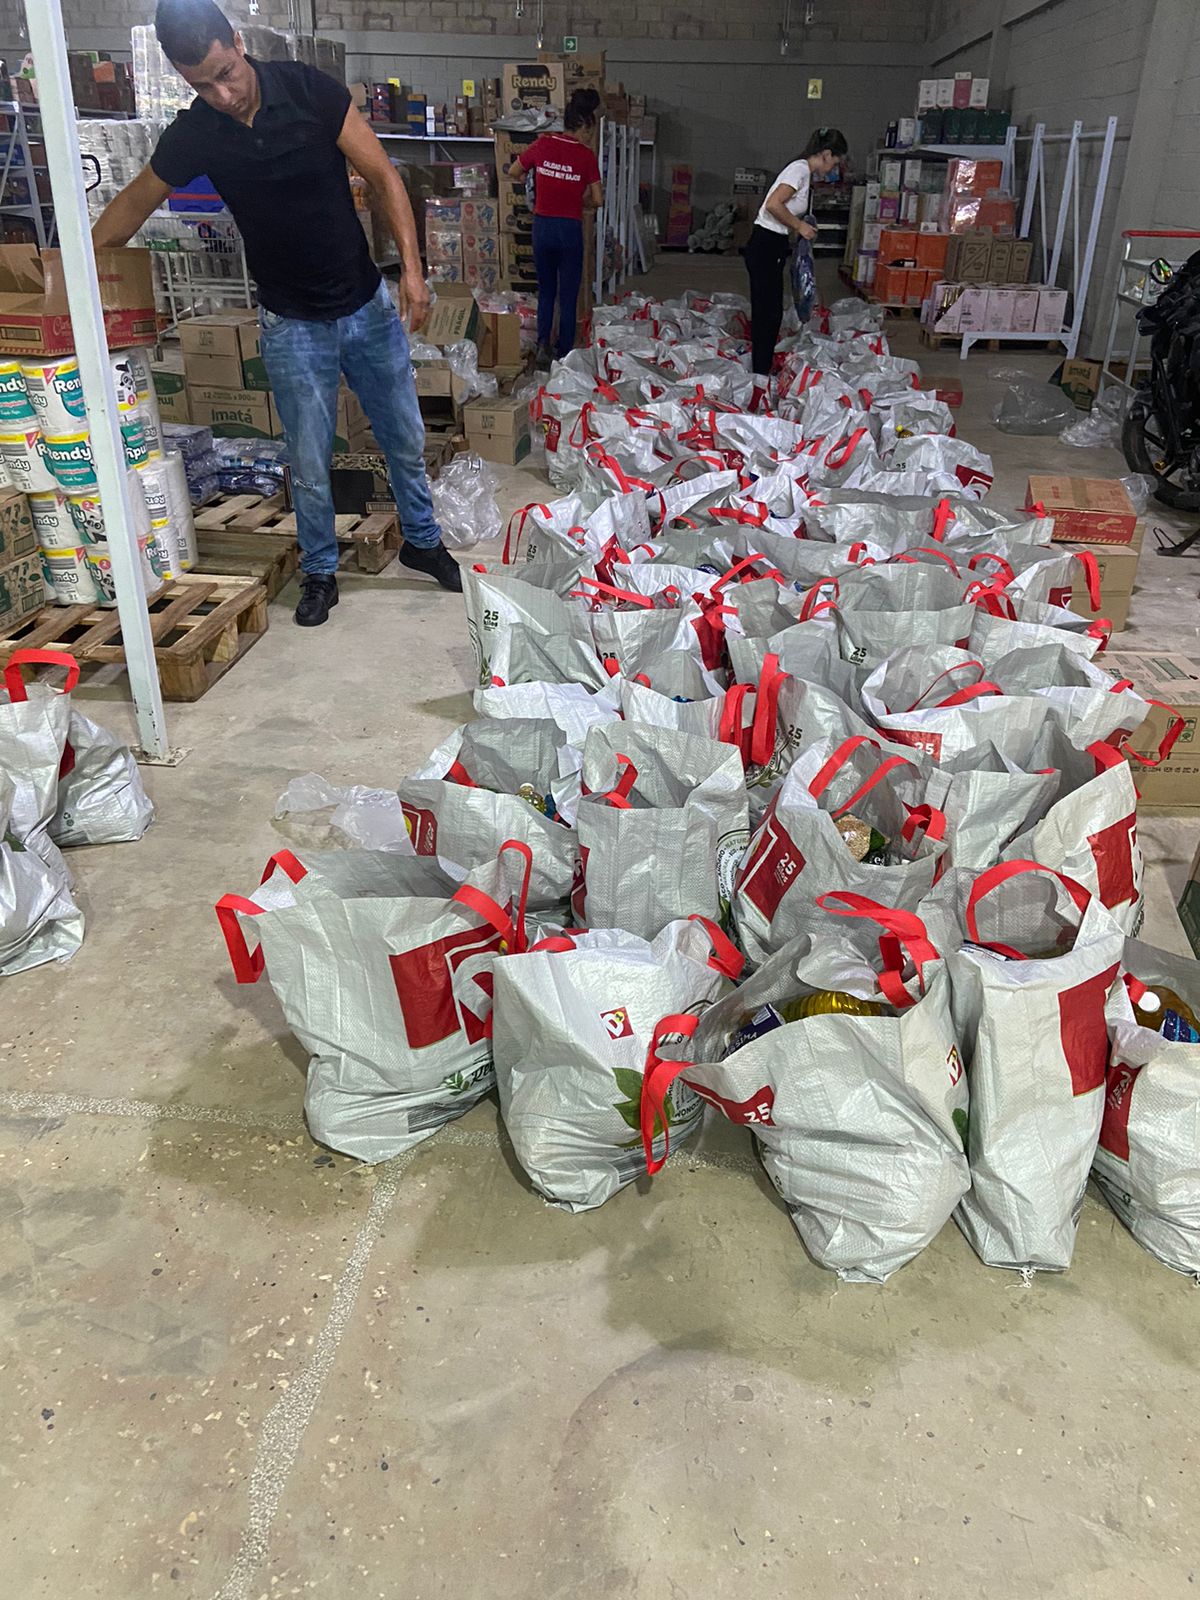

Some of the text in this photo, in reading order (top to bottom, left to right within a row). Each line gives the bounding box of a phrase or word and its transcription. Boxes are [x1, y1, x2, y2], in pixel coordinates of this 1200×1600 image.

[512, 74, 557, 91] Rendy
[811, 84, 819, 95] A
[561, 165, 573, 173] ALTA
[555, 171, 566, 179] MUY
[565, 173, 581, 181] BAJOS
[0, 377, 27, 393] ndy
[53, 378, 81, 394] Ren
[211, 408, 253, 424] Imatá
[126, 445, 148, 460] ndy
[8, 459, 31, 471] ndy
[35, 515, 59, 527] ndy
[528, 544, 537, 554] 25
[55, 571, 78, 583] ndy
[484, 609, 499, 621] 25
[852, 647, 867, 658] 25
[788, 724, 803, 740] 25
[779, 852, 797, 875] 25
[743, 1102, 770, 1122] 25
